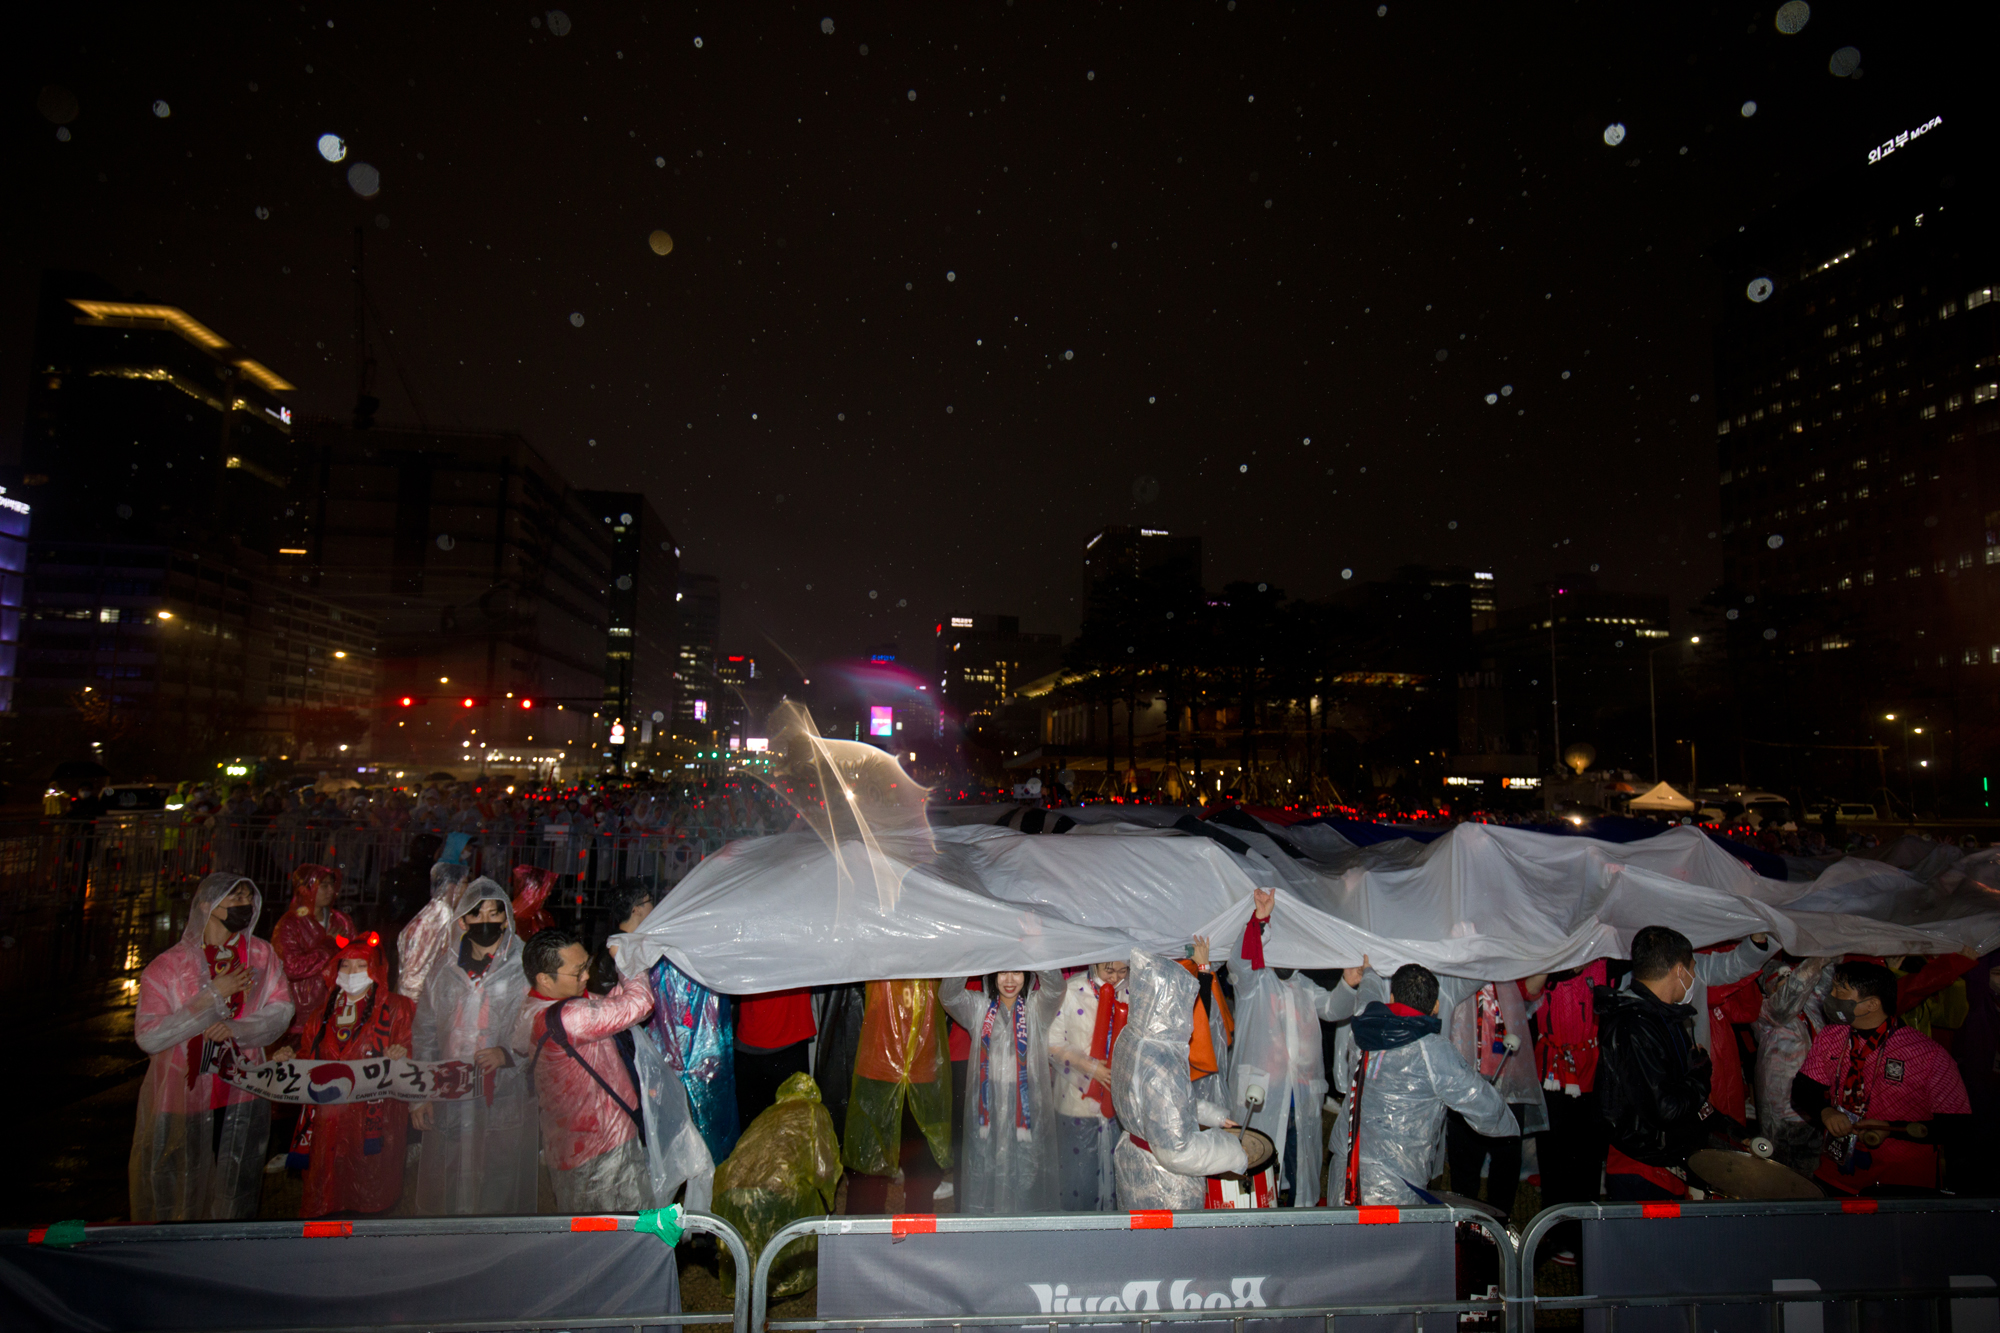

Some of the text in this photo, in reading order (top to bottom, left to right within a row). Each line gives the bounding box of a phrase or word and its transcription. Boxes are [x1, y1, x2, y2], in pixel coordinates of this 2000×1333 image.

[1867, 115, 1943, 165] 외교부 MOFA
[355, 1091, 377, 1100] CARRY
[1828, 1144, 1843, 1158] PASS
[1831, 1140, 1842, 1151] ALL
